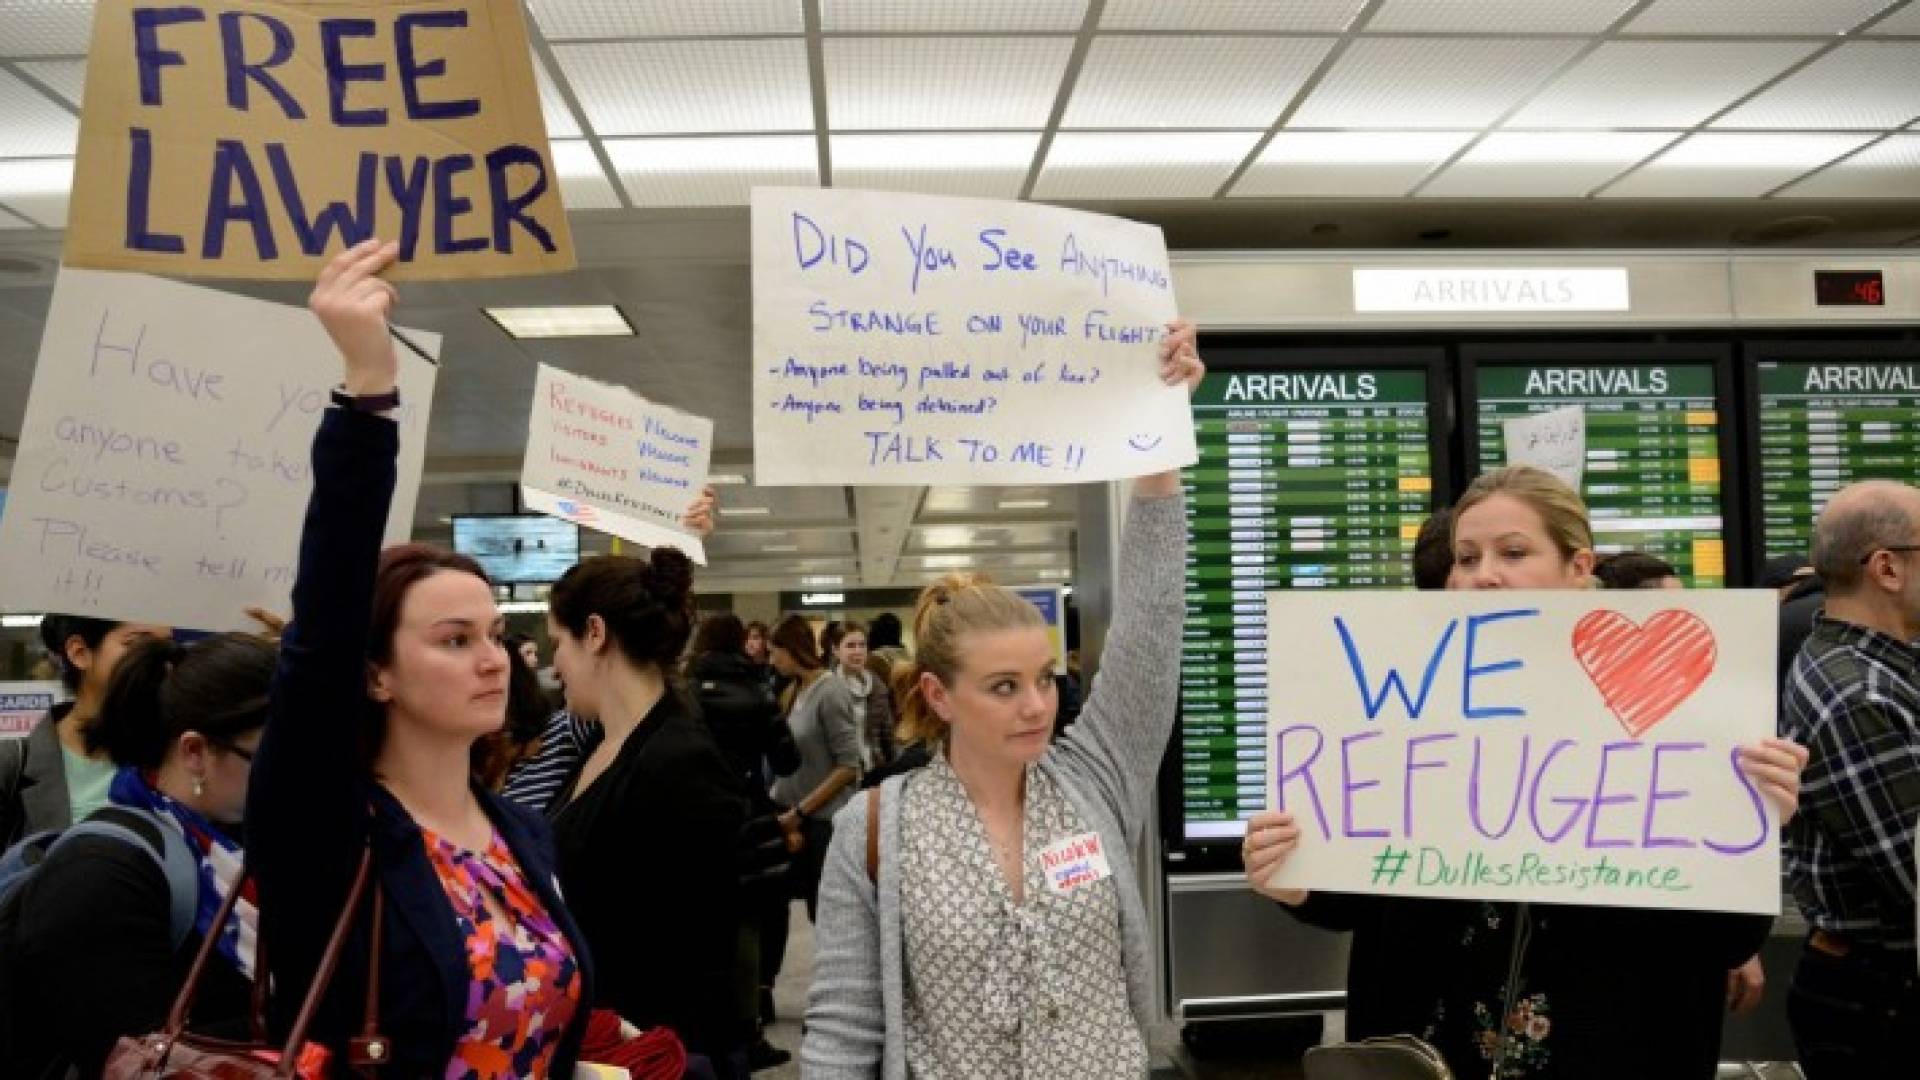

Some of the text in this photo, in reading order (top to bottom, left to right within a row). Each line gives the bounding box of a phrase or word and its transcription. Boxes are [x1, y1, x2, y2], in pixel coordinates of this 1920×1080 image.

[133, 8, 480, 126] FREE
[125, 127, 557, 262] LAWYER
[793, 212, 868, 274] DID
[979, 229, 1040, 271] See
[1413, 278, 1575, 304] ARRIVALS
[809, 301, 939, 335] STRANGE
[967, 315, 1002, 335] ON
[1018, 312, 1067, 350] YOUR
[89, 310, 225, 401] Have
[266, 383, 330, 433] yo
[858, 356, 907, 391] being
[919, 361, 969, 391] pulled
[983, 366, 1009, 383] out
[1022, 361, 1046, 384] of
[1224, 374, 1378, 401] ARRIVALS
[1525, 368, 1668, 395] ARRIVALS
[1804, 365, 1920, 391] ARRIVAL
[858, 394, 904, 425] being
[916, 395, 997, 415] detained?
[55, 416, 185, 464] anyone
[864, 432, 944, 468] TALK
[959, 439, 999, 463] TO
[33, 516, 294, 584] Please tell m
[1334, 609, 1541, 720] WE
[1276, 724, 1770, 855] REFUGEES
[1371, 844, 1694, 892] #DullesResistance
